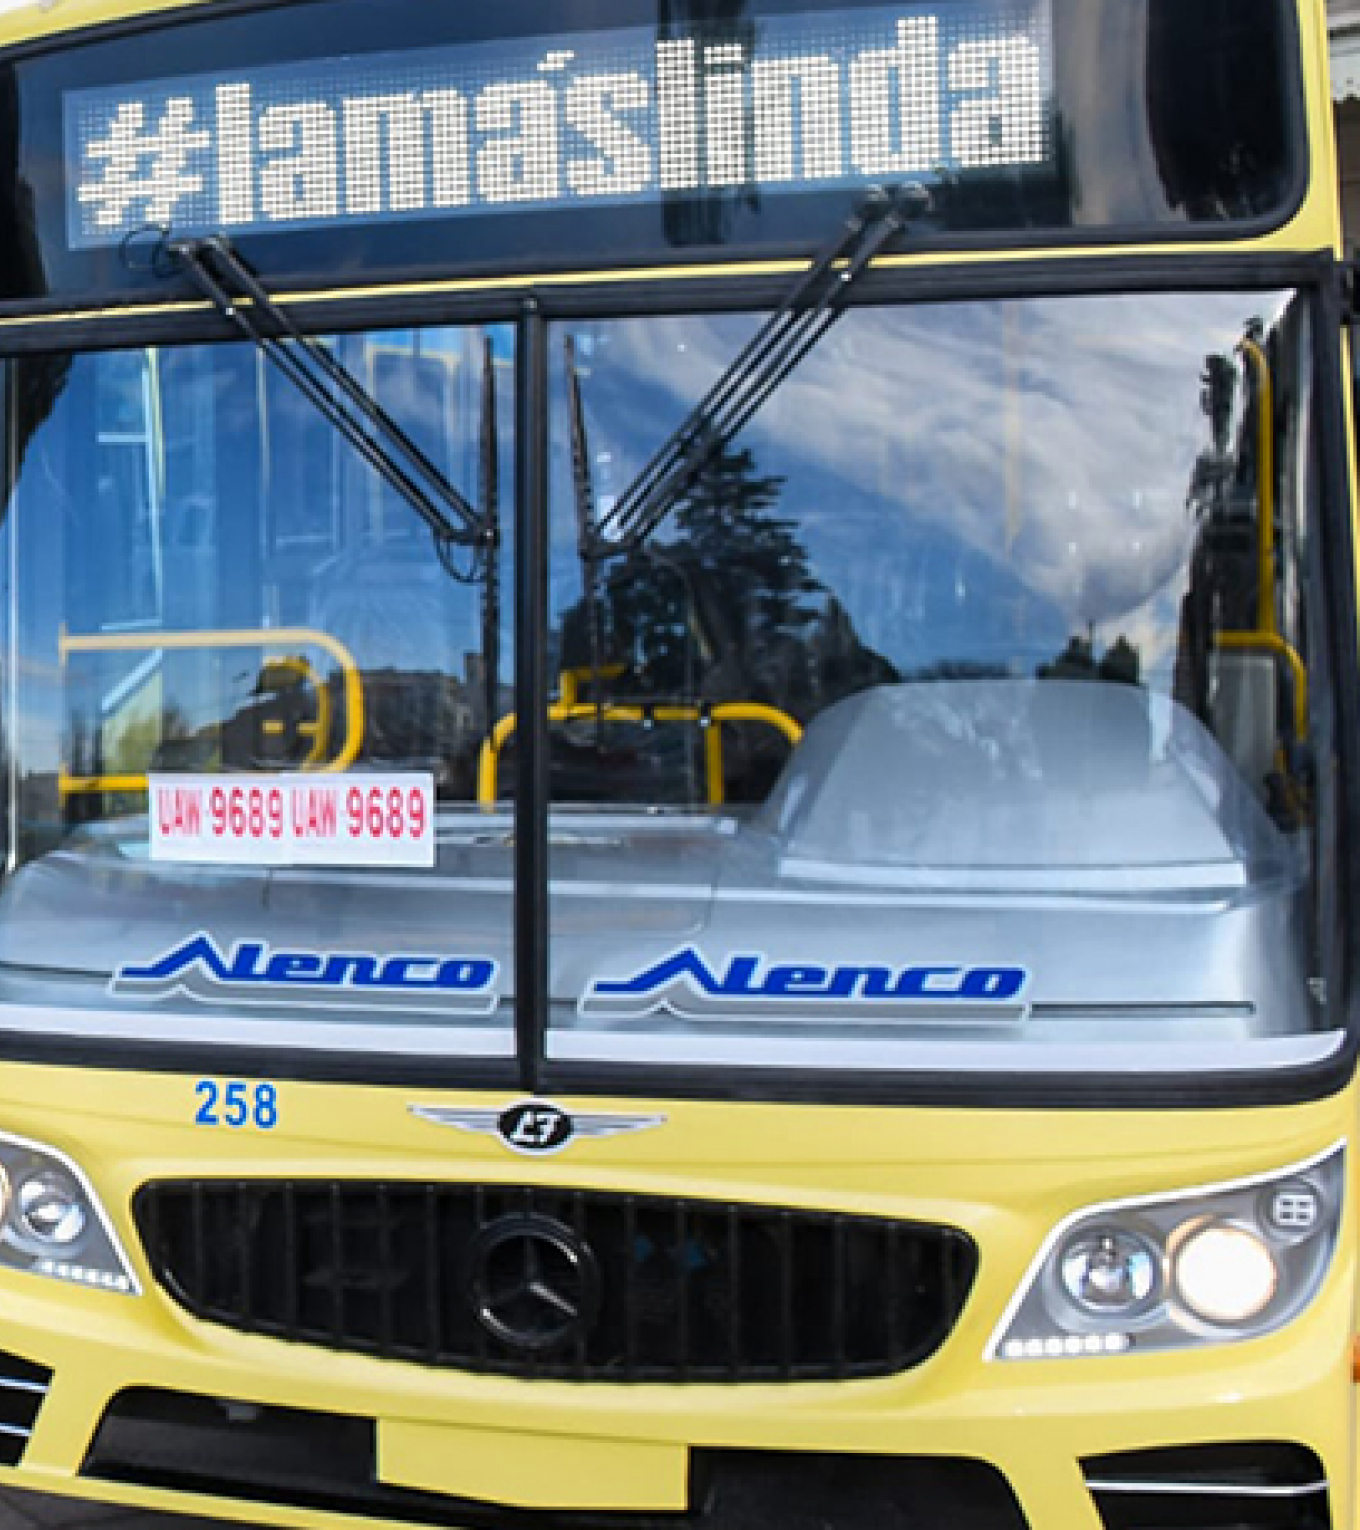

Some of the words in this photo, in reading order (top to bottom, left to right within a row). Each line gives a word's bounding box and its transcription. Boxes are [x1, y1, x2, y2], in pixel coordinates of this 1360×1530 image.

[78, 16, 1048, 225] #lamáslinda
[209, 786, 283, 839] 9689
[346, 786, 427, 840] 9689
[122, 936, 496, 989] Alenco
[595, 948, 1027, 1000] Alenco
[195, 1080, 278, 1129] 258
